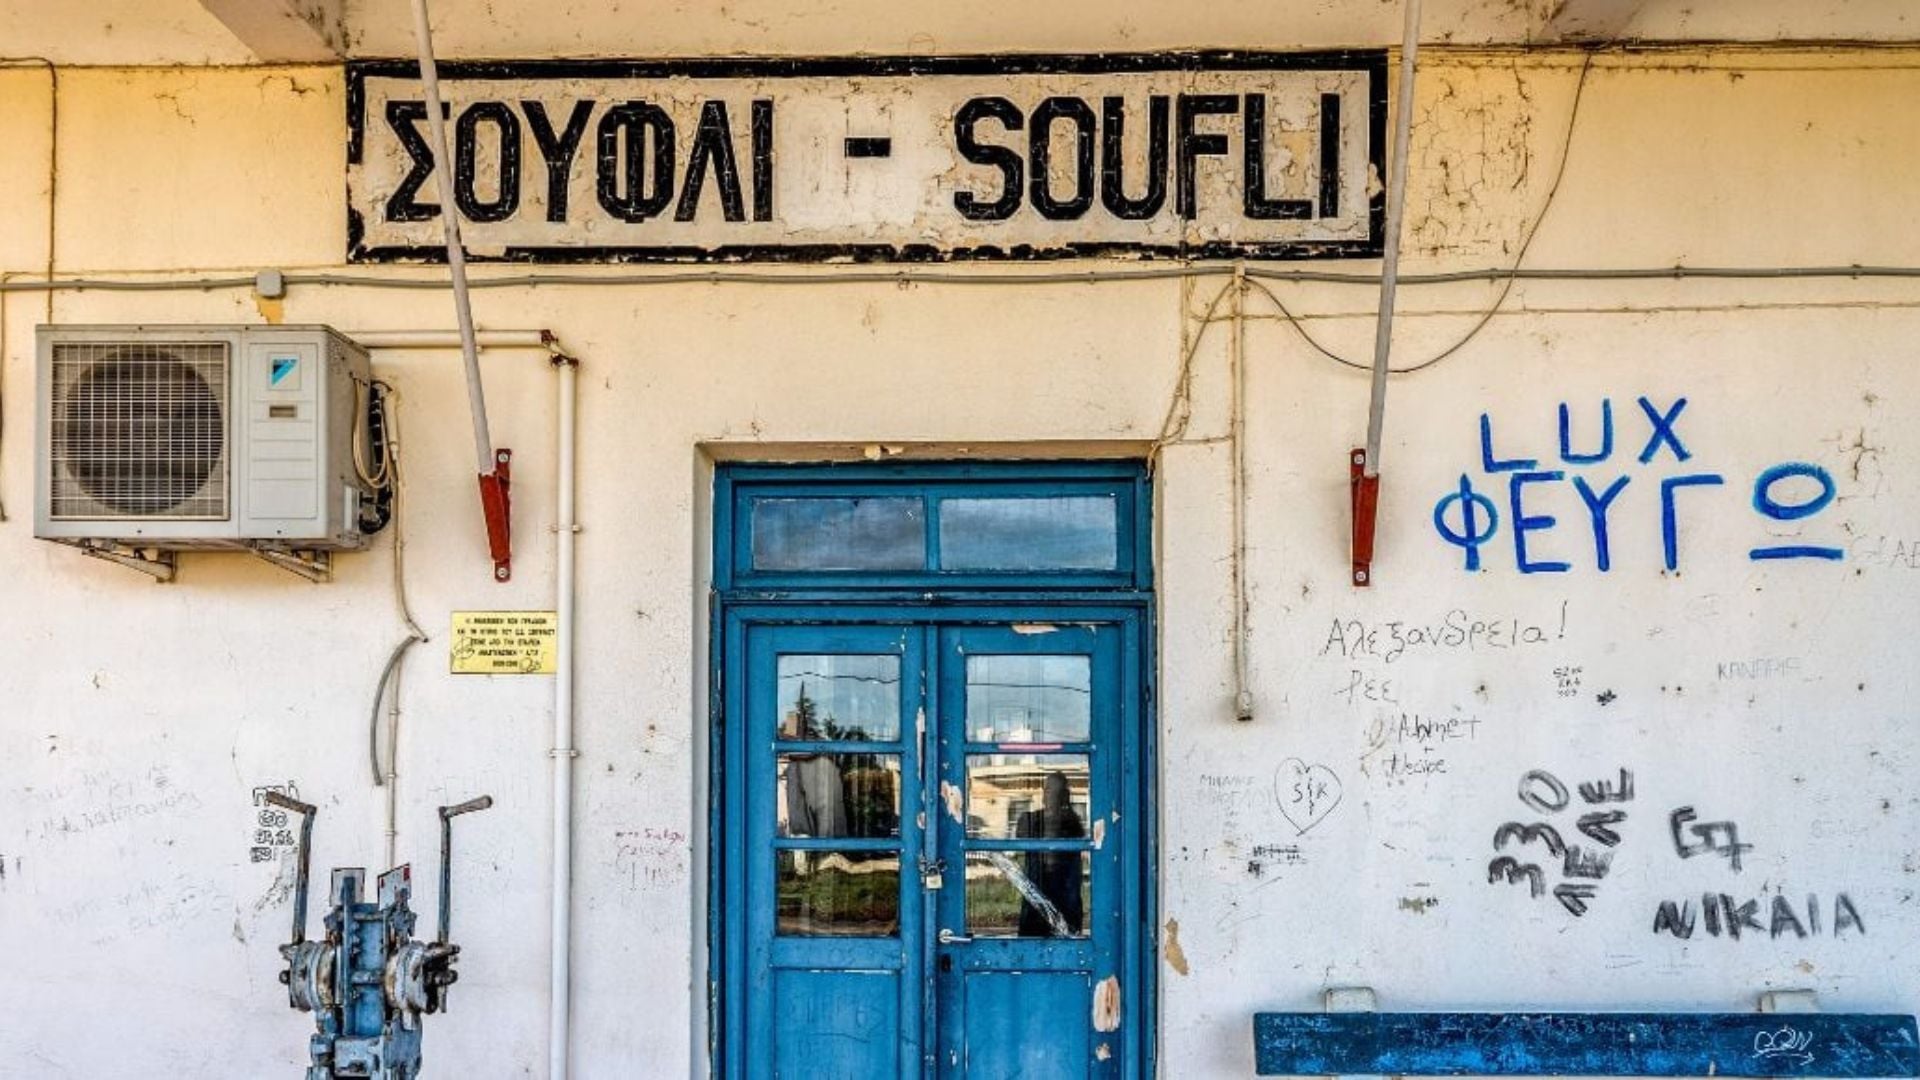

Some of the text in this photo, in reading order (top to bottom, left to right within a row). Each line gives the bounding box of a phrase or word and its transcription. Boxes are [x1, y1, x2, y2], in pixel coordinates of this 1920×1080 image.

[385, 99, 774, 223] ΣΟΥΦΛΙ
[954, 93, 1340, 220] SOUFLI
[1480, 396, 1691, 473] LUX
